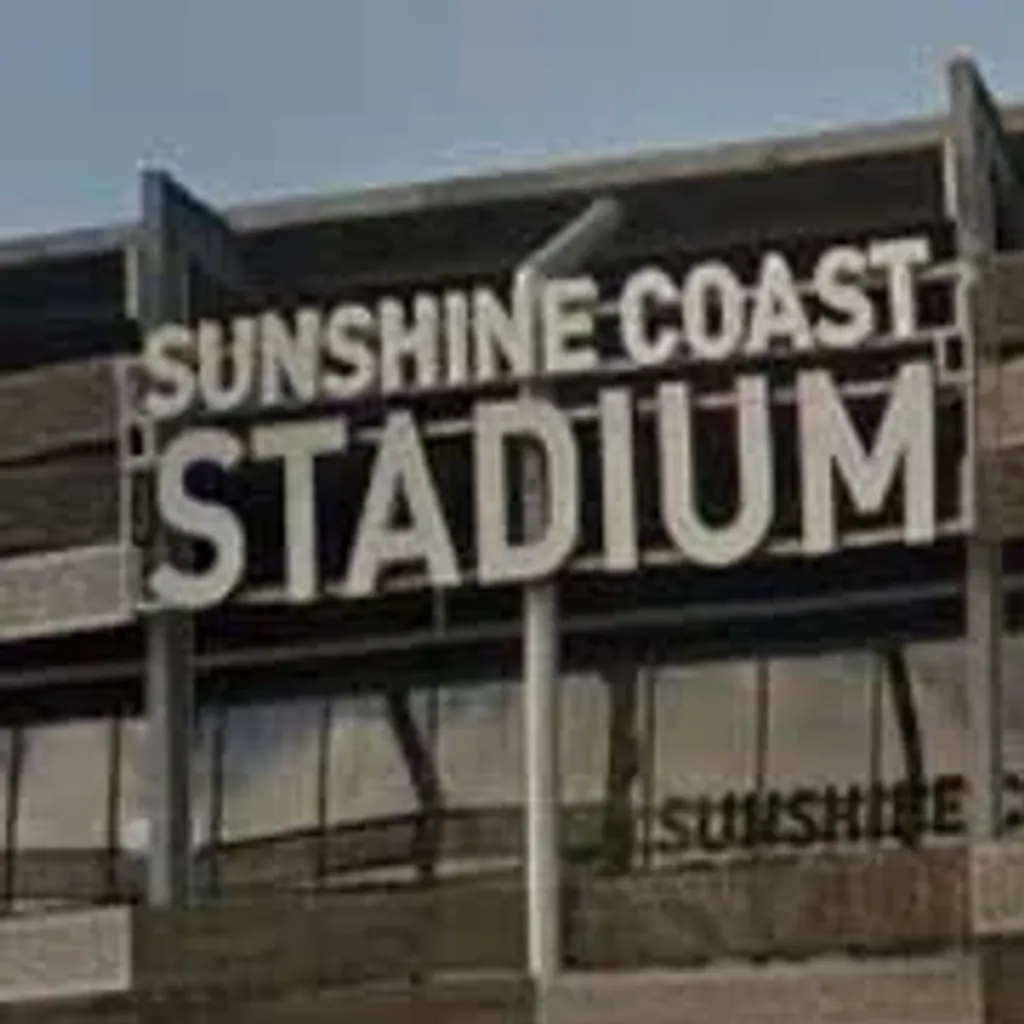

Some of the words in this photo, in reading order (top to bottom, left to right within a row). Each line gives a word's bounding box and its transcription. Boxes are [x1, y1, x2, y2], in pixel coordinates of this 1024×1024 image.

[145, 275, 598, 419] SUNSHINE
[619, 238, 932, 367] COAST
[149, 362, 937, 611] STADIUM
